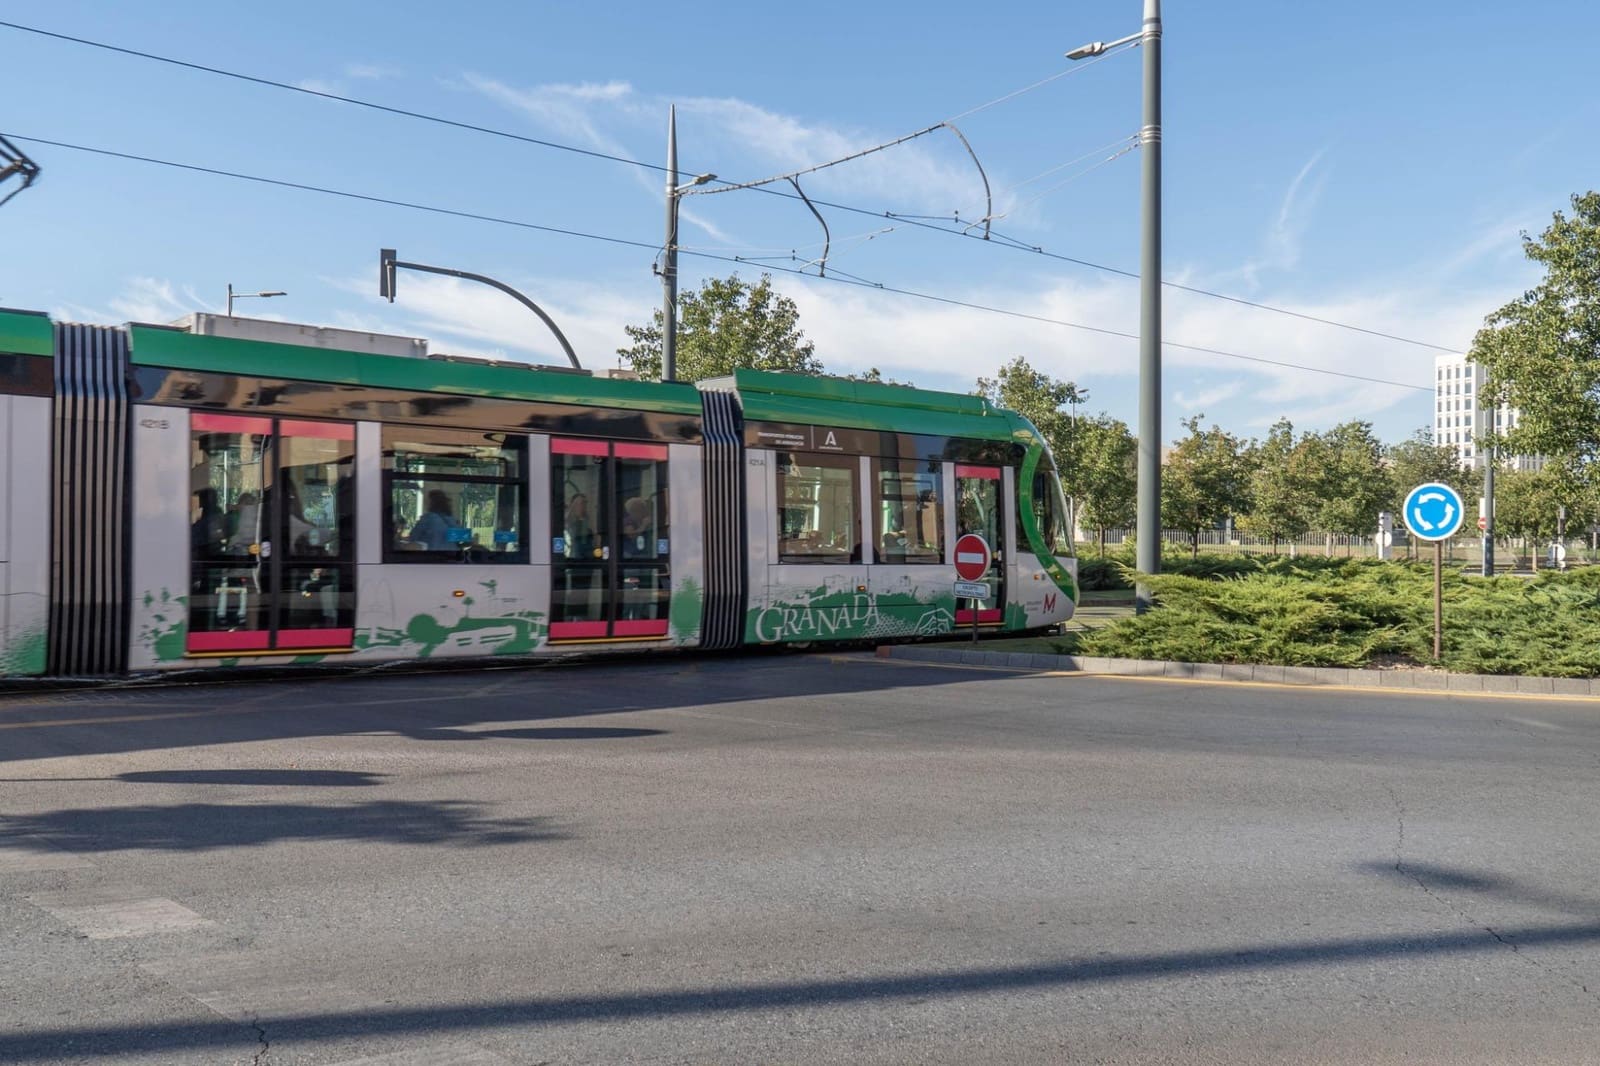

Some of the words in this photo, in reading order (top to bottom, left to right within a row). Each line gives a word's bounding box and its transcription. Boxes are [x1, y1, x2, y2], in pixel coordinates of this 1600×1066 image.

[824, 431, 837, 446] A
[1042, 592, 1057, 614] M
[755, 594, 881, 642] GRANADA
